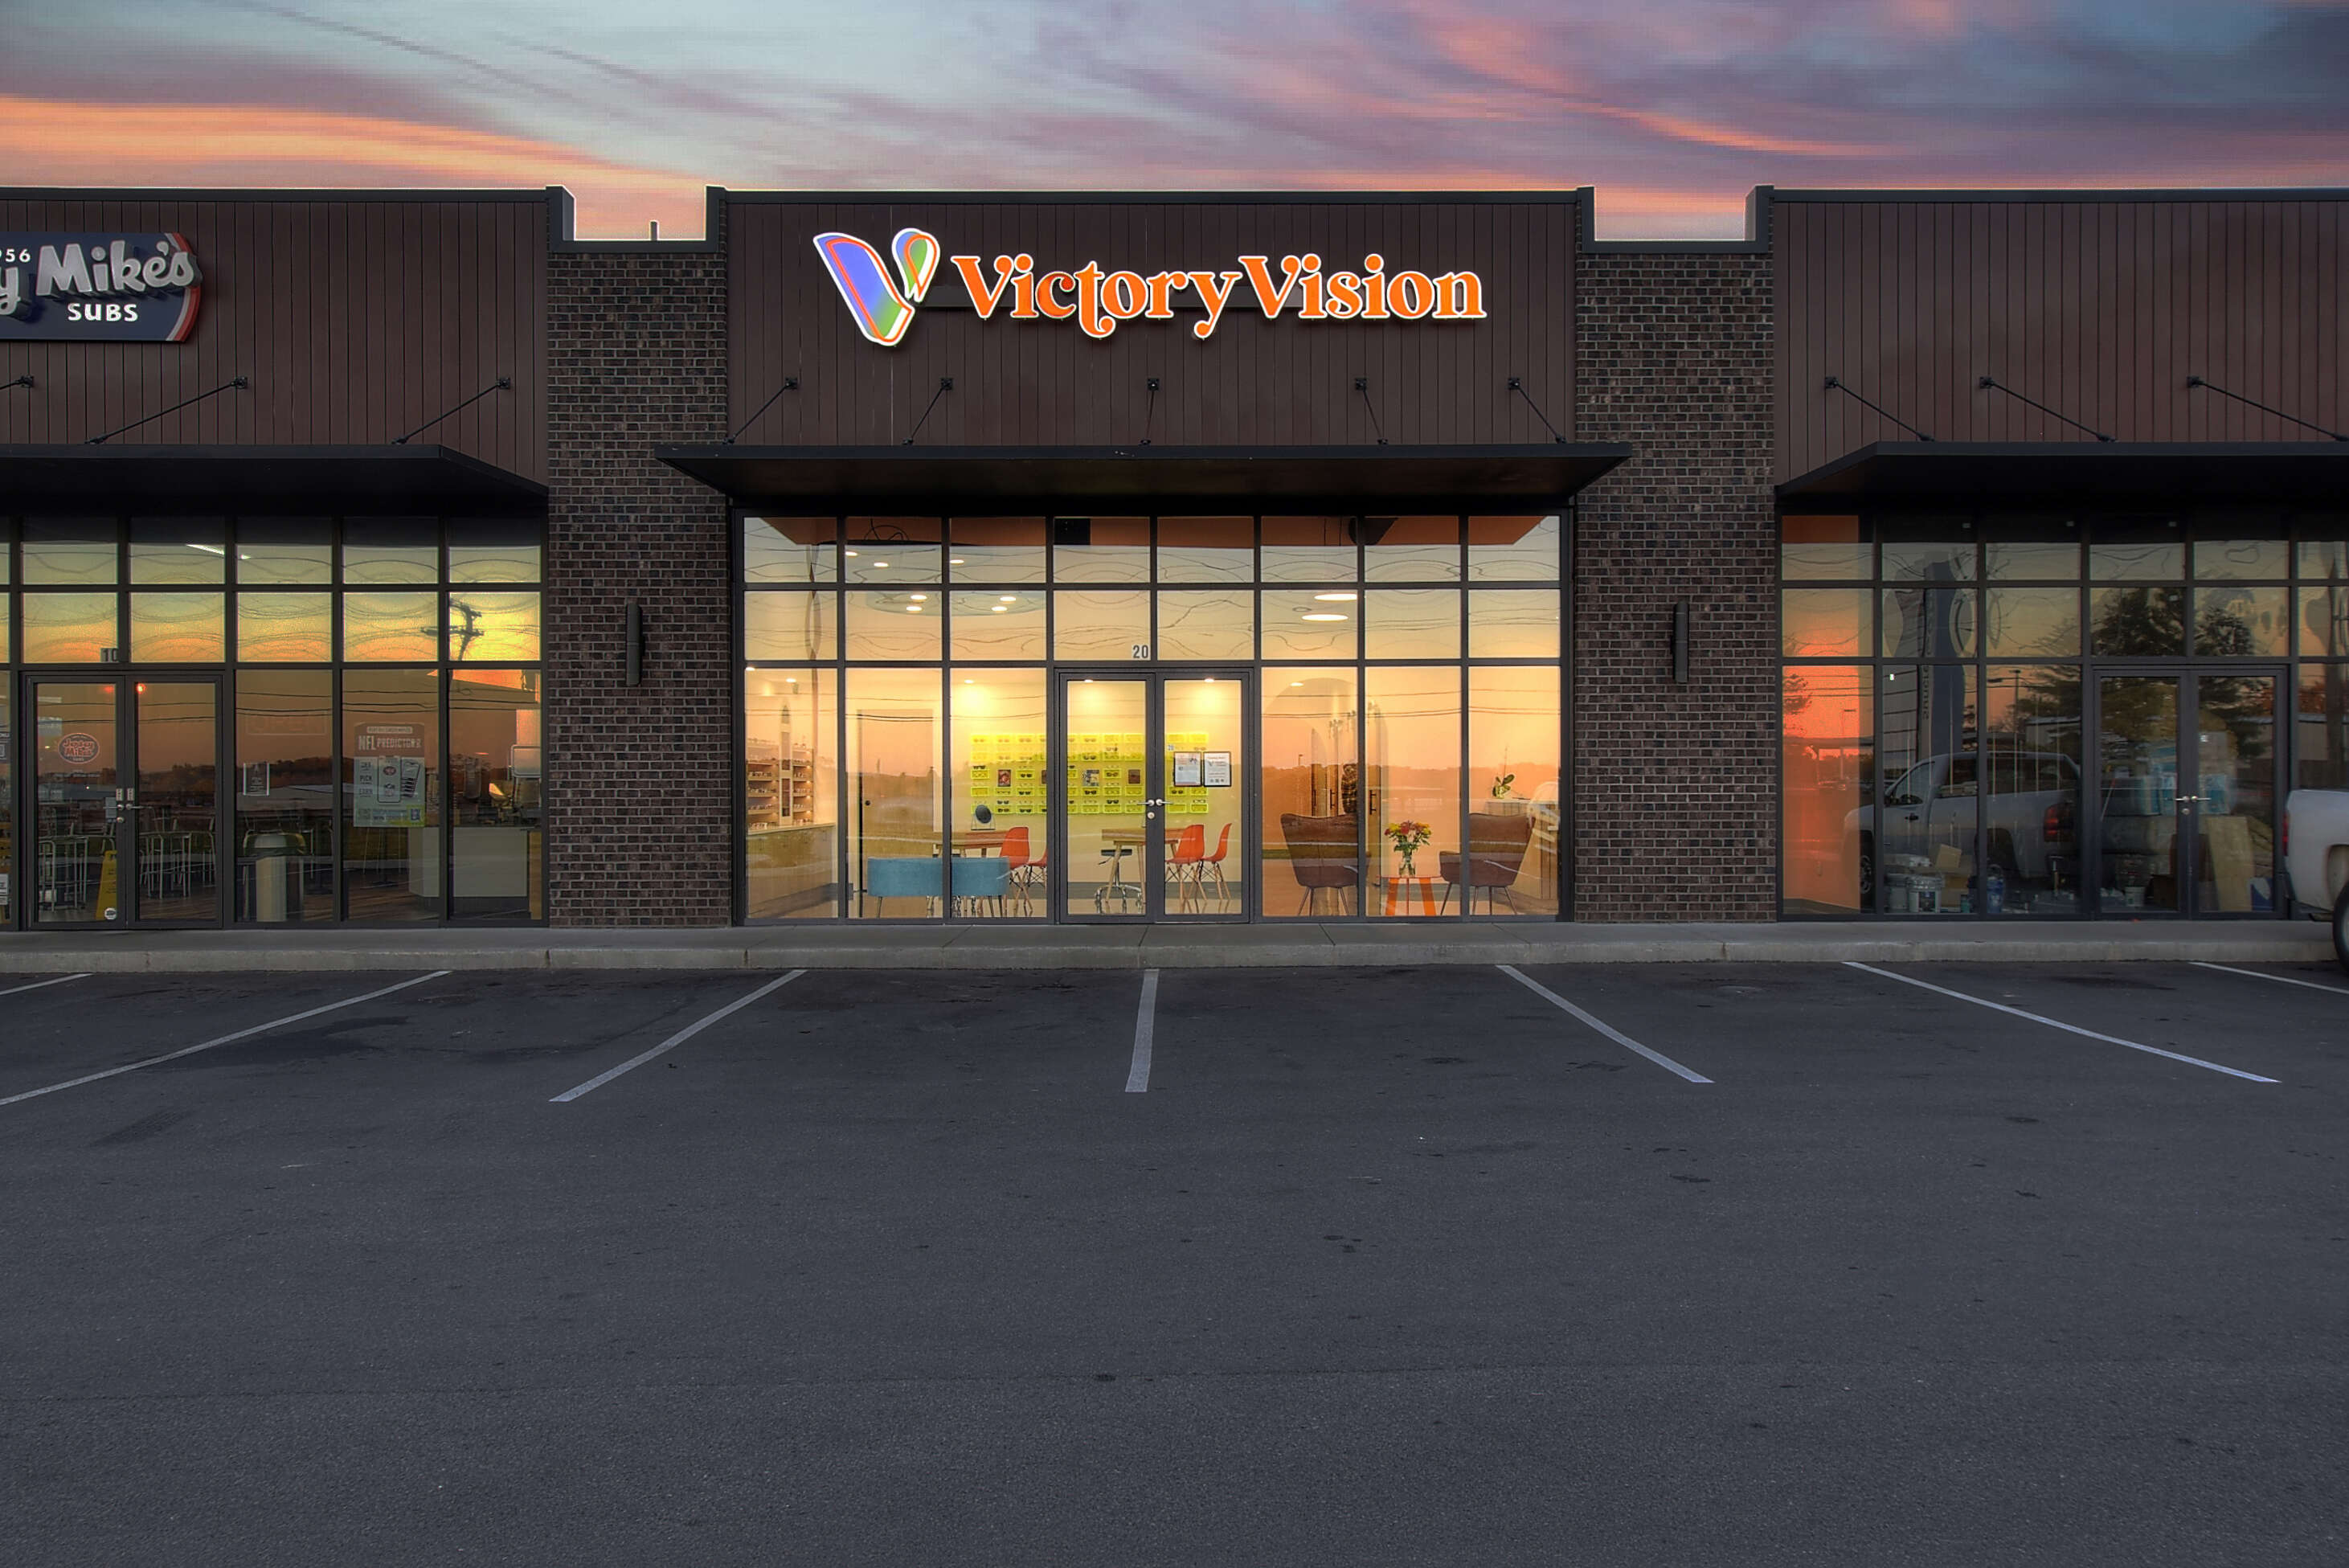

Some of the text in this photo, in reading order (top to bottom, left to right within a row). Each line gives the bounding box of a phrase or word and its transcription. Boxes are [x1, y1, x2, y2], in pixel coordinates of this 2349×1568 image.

[37, 240, 194, 296] Mike's
[68, 303, 138, 321] SUBS
[103, 649, 119, 661] 10
[1132, 645, 1149, 658] 20
[358, 735, 377, 750] NFL
